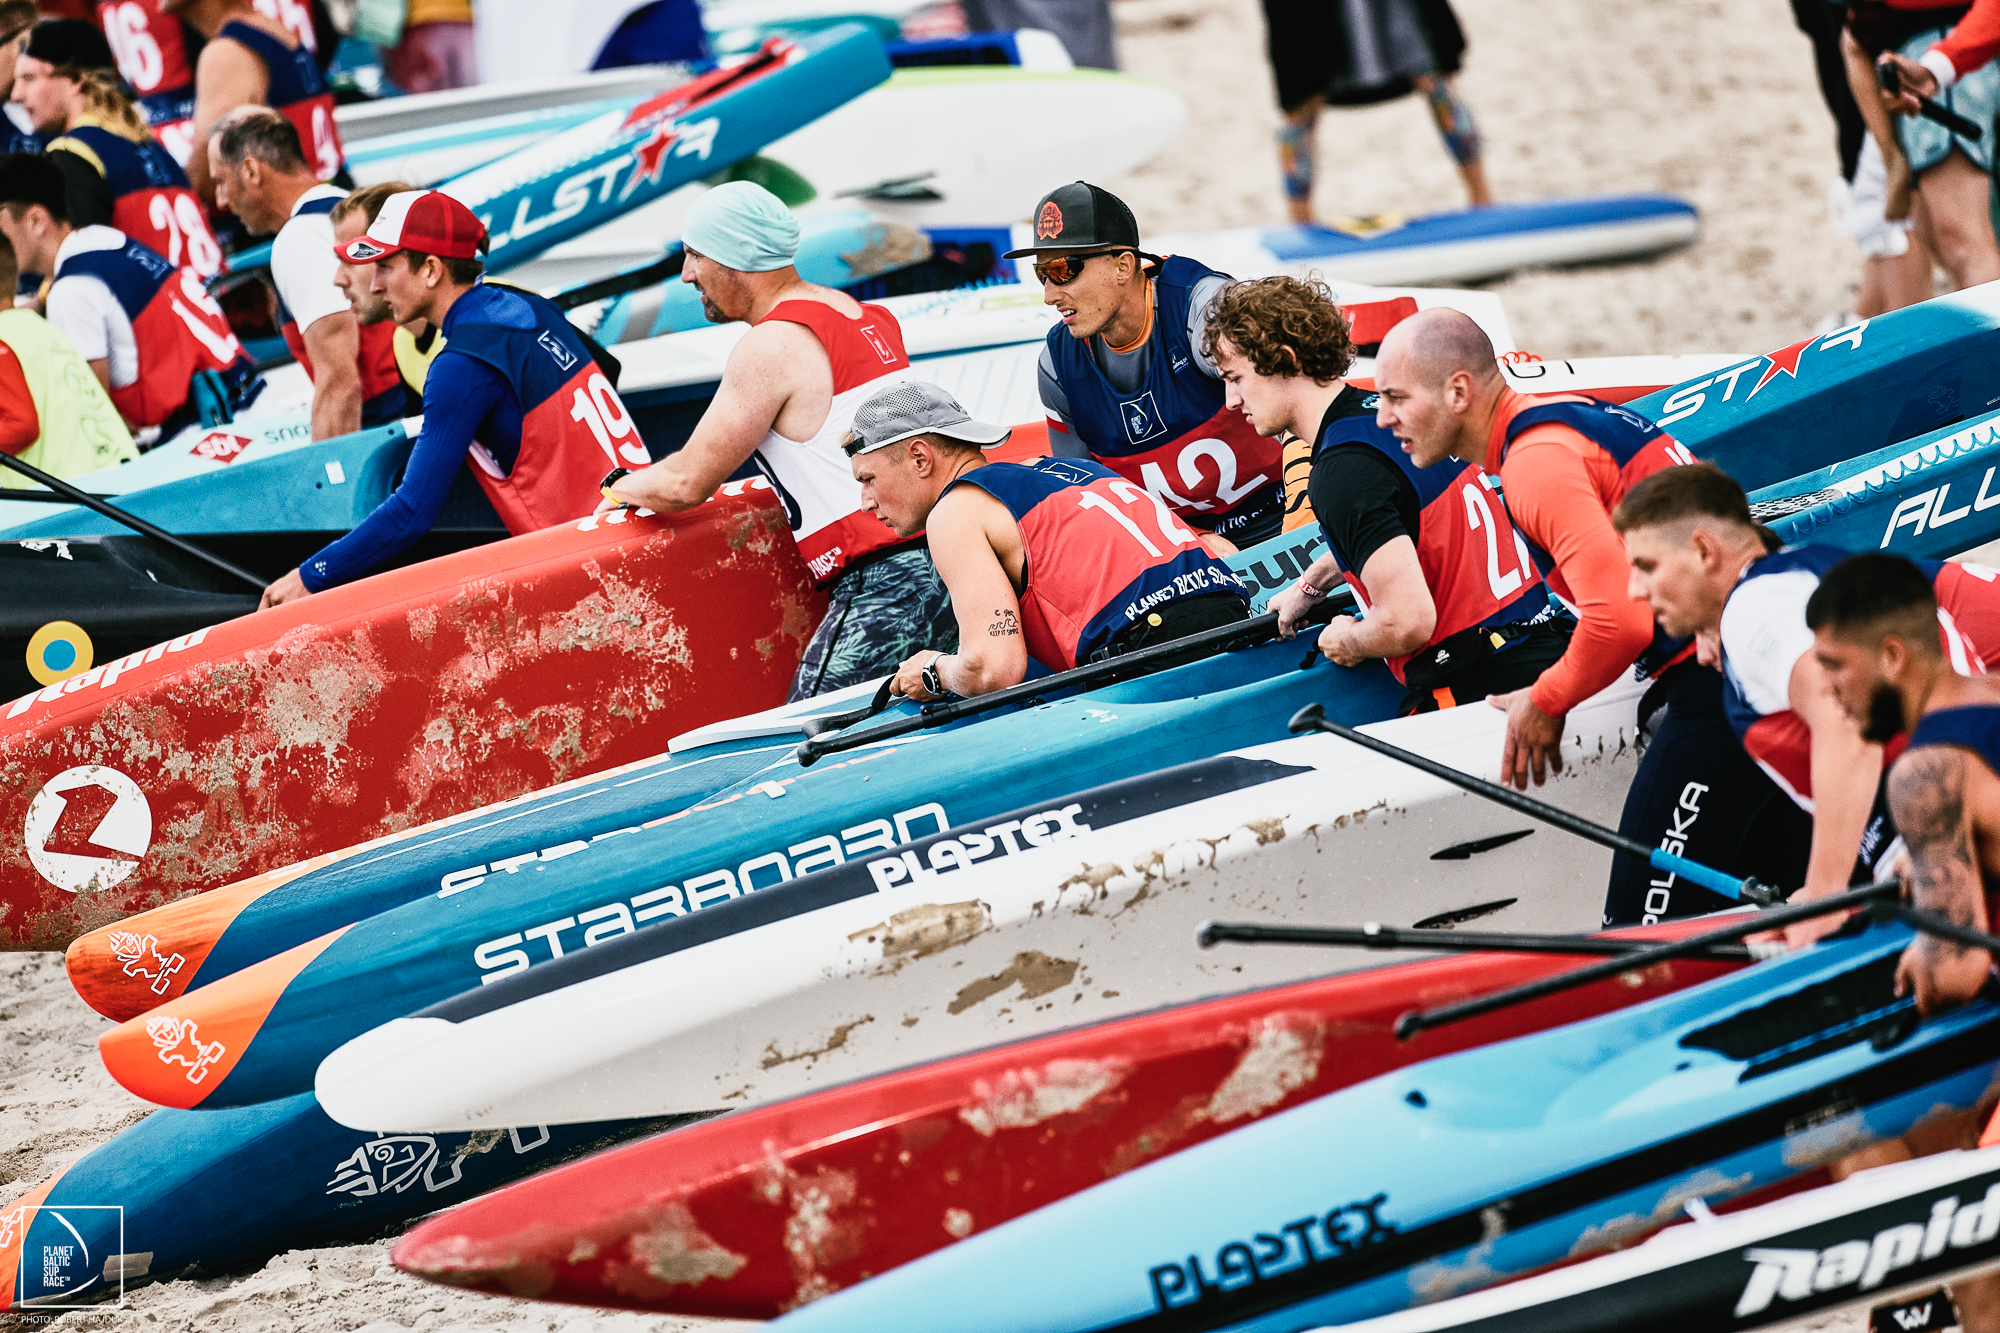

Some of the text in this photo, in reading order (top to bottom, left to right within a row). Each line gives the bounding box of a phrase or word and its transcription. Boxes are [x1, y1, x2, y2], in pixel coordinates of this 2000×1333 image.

[103, 2, 164, 91] 16
[570, 372, 652, 469] 19
[1078, 481, 1197, 557] 12
[1125, 584, 1175, 621] PLANET
[474, 802, 950, 987] STARBOARD
[866, 803, 1093, 893] PLASTEX
[1642, 781, 1710, 926] POLSKA
[1149, 1191, 1397, 1314] PLASTEX
[1733, 1181, 2000, 1318] Rapid
